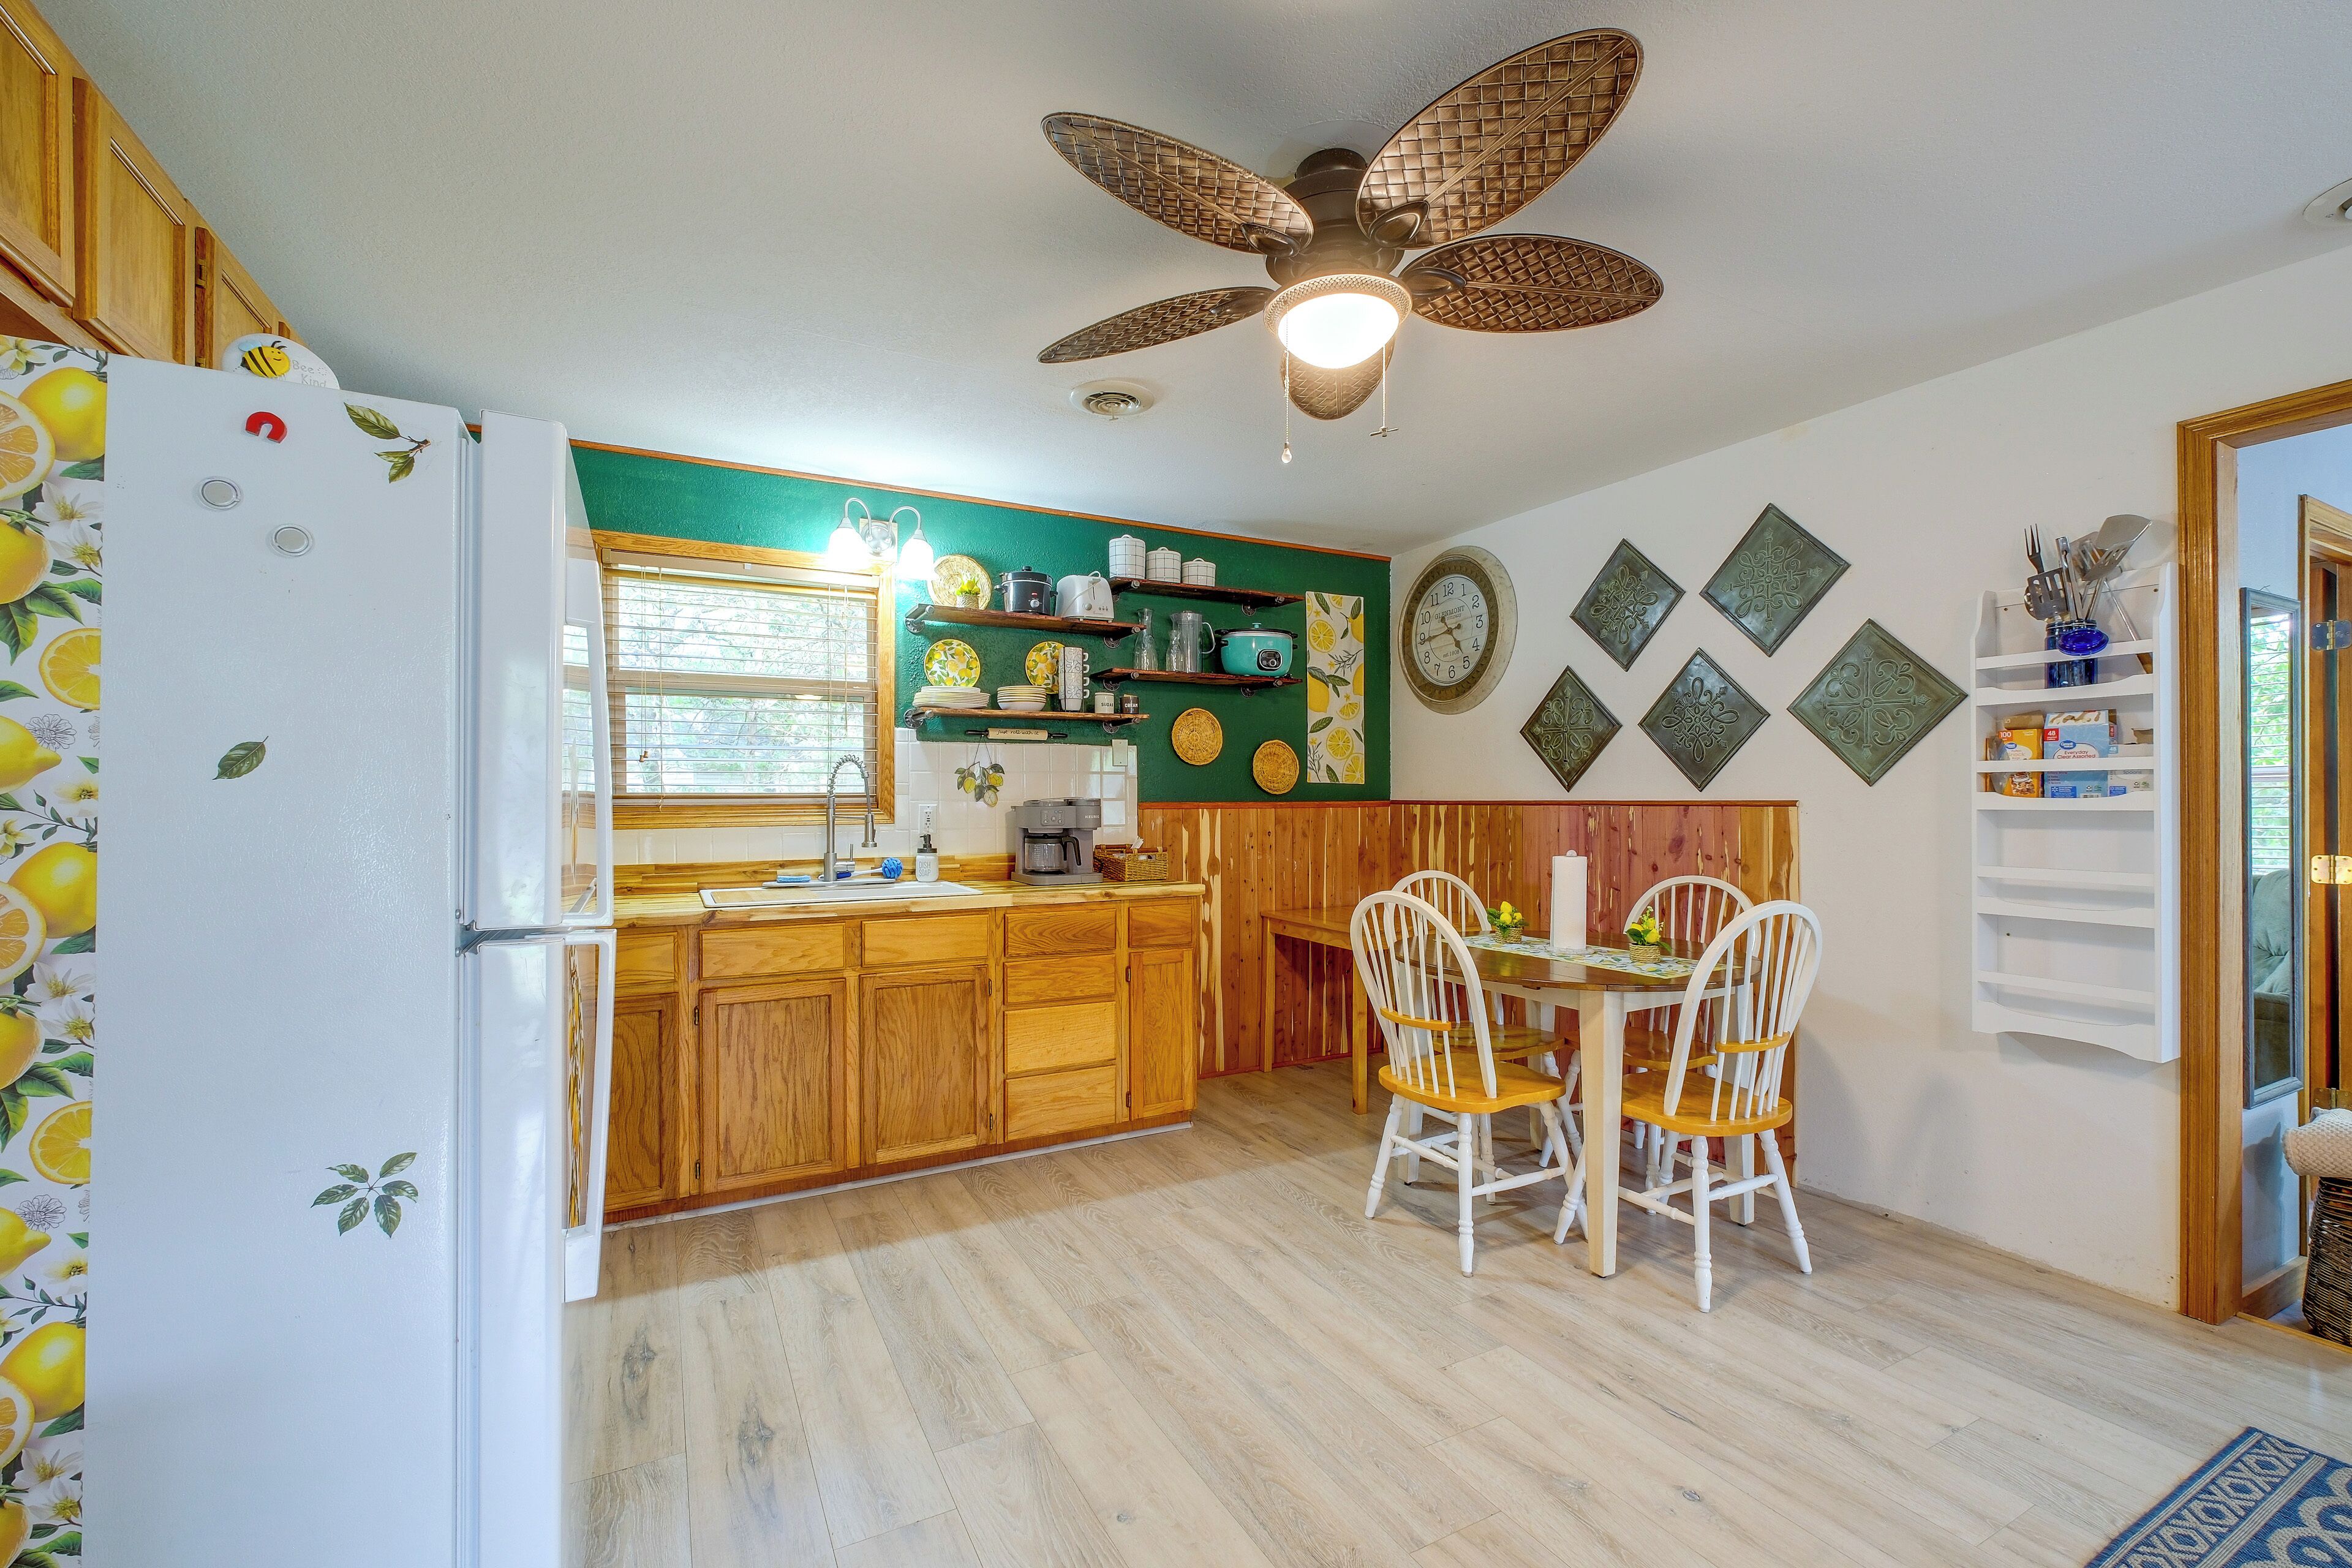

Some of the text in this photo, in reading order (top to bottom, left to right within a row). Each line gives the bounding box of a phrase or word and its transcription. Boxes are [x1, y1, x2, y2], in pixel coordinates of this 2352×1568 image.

[292, 360, 314, 374] Bee
[301, 374, 326, 387] Kind
[1443, 582, 1454, 597] 12
[1461, 584, 1466, 597] 1
[1430, 593, 1439, 607] 11
[1472, 595, 1480, 609] 2
[1421, 611, 1431, 625] 10
[1434, 605, 1464, 619] GLENMONT
[1476, 614, 1483, 628] 3
[1419, 633, 1425, 645] 9
[1472, 638, 1480, 651] 4
[1424, 651, 1430, 664] 8
[1463, 656, 1470, 669] 5
[1434, 663, 1441, 676] 7
[1448, 665, 1455, 679] 6
